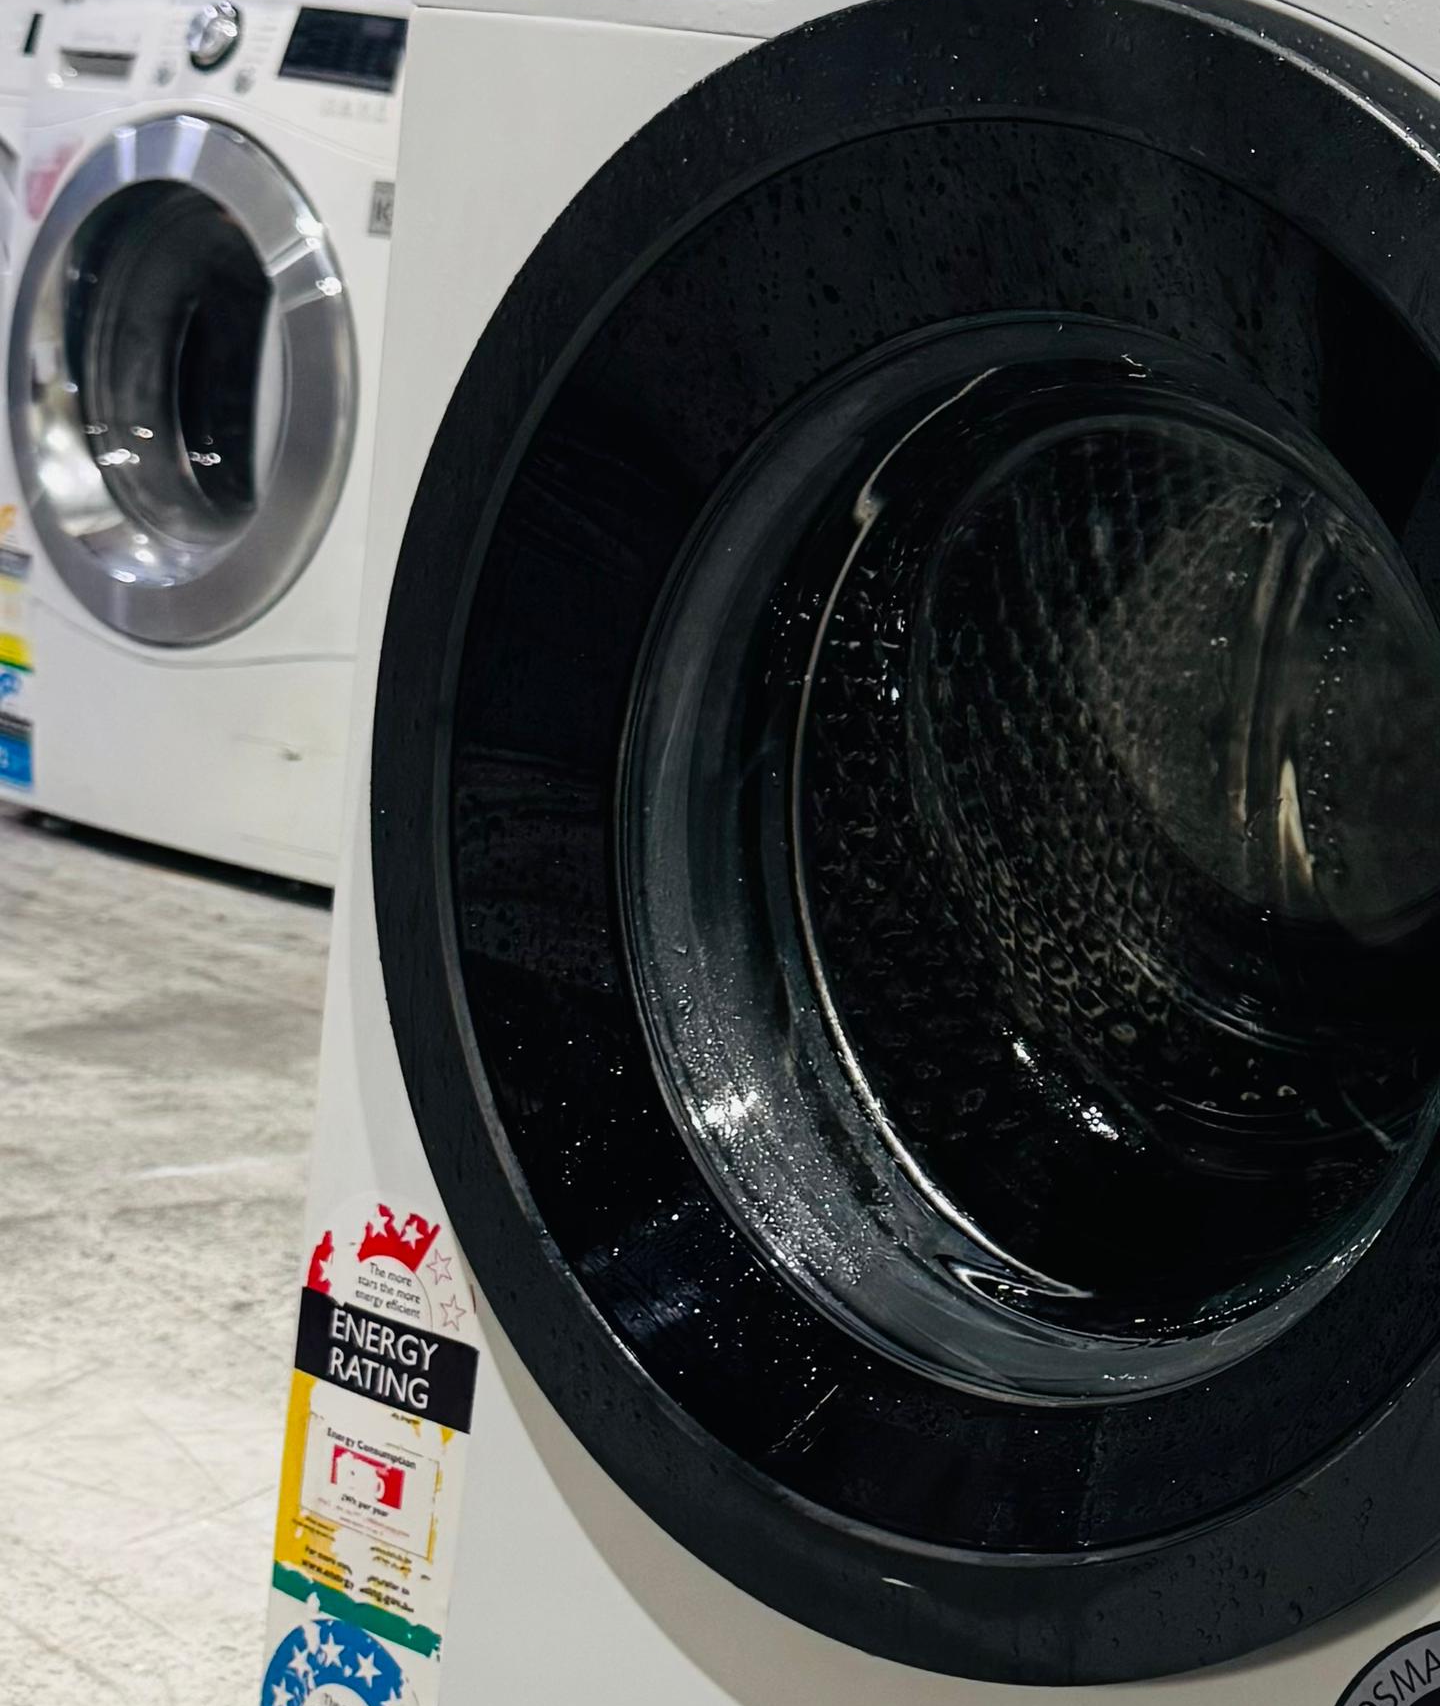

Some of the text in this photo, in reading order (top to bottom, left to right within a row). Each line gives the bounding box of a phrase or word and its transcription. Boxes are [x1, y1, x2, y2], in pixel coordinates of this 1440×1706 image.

[357, 1275, 421, 1305] stars the more
[370, 1262, 413, 1287] The more
[355, 1289, 421, 1320] energy efficient
[331, 1307, 440, 1372] ENERGY
[329, 1346, 430, 1410] RATING
[356, 1439, 417, 1470] Consumption
